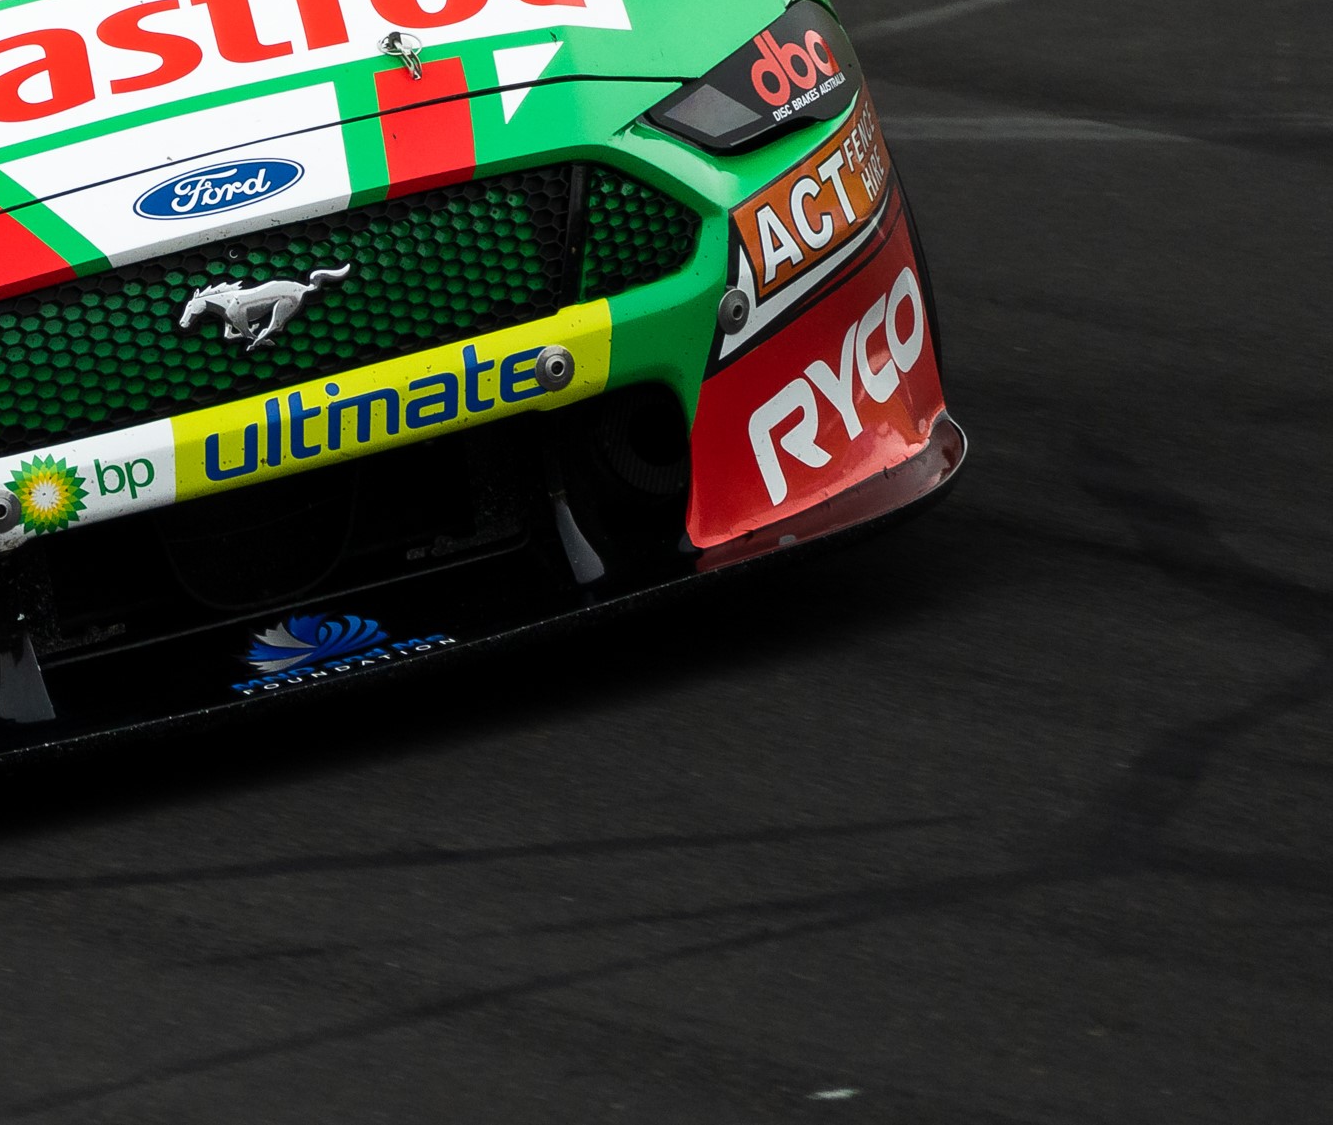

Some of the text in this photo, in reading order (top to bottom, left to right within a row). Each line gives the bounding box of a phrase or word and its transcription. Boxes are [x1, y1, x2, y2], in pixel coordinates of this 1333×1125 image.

[750, 28, 842, 107] dba
[772, 71, 847, 122] DISC BRAKES AUSTRALIA
[842, 99, 875, 173] FENCE
[171, 167, 271, 215] Ford
[860, 143, 885, 203] HIRE
[758, 149, 859, 286] ACT
[204, 343, 548, 483] ultimate
[747, 265, 925, 507] RYCO
[94, 456, 156, 499] bp
[231, 666, 316, 691] MND
[242, 637, 457, 696] FOUNDATION
